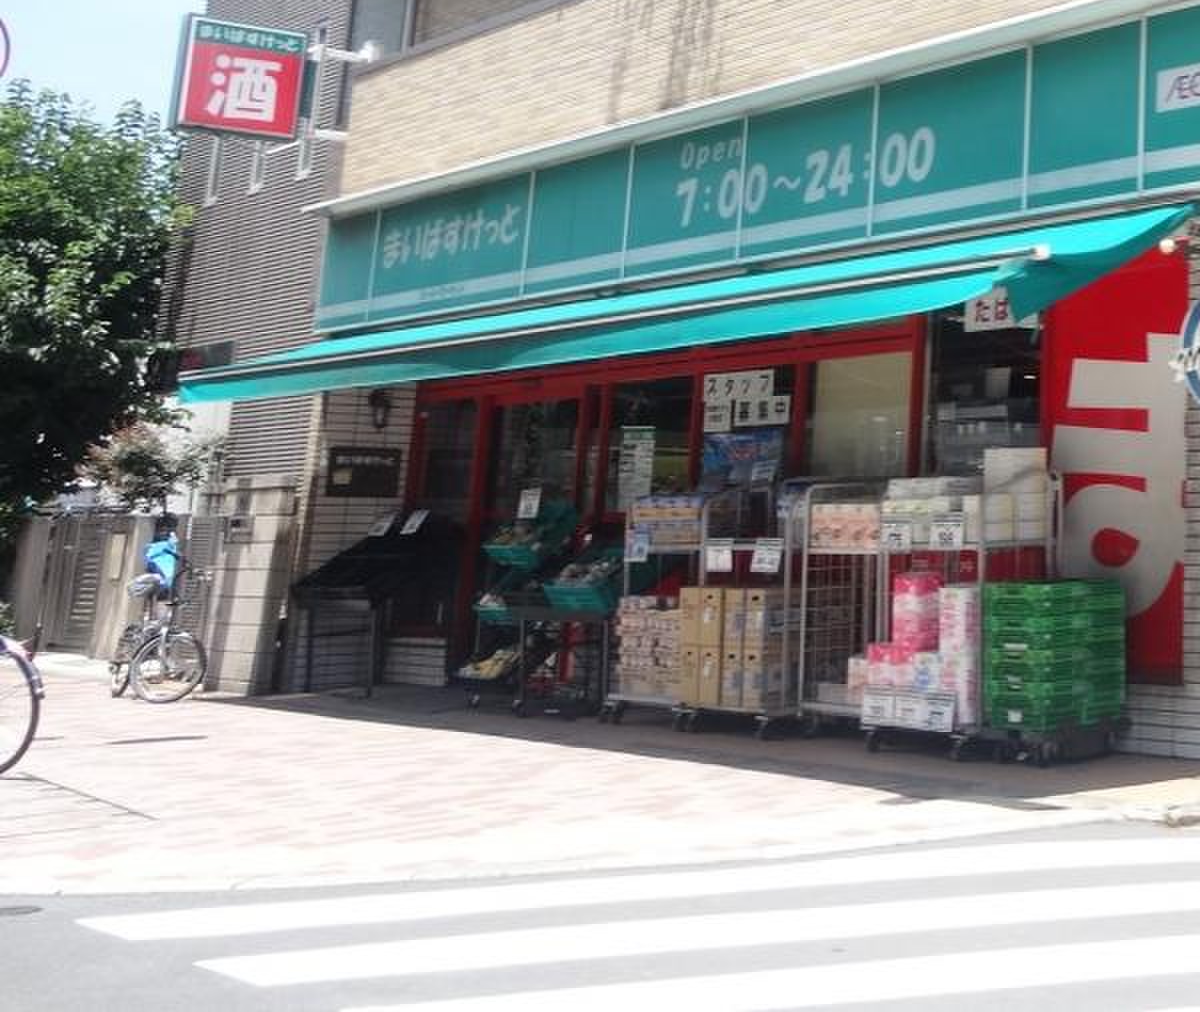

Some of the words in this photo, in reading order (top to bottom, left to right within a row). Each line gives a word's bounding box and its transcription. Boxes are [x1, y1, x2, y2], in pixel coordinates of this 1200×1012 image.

[205, 53, 283, 123] 酒
[680, 138, 743, 170] Open
[383, 204, 521, 268] まいばすけっと
